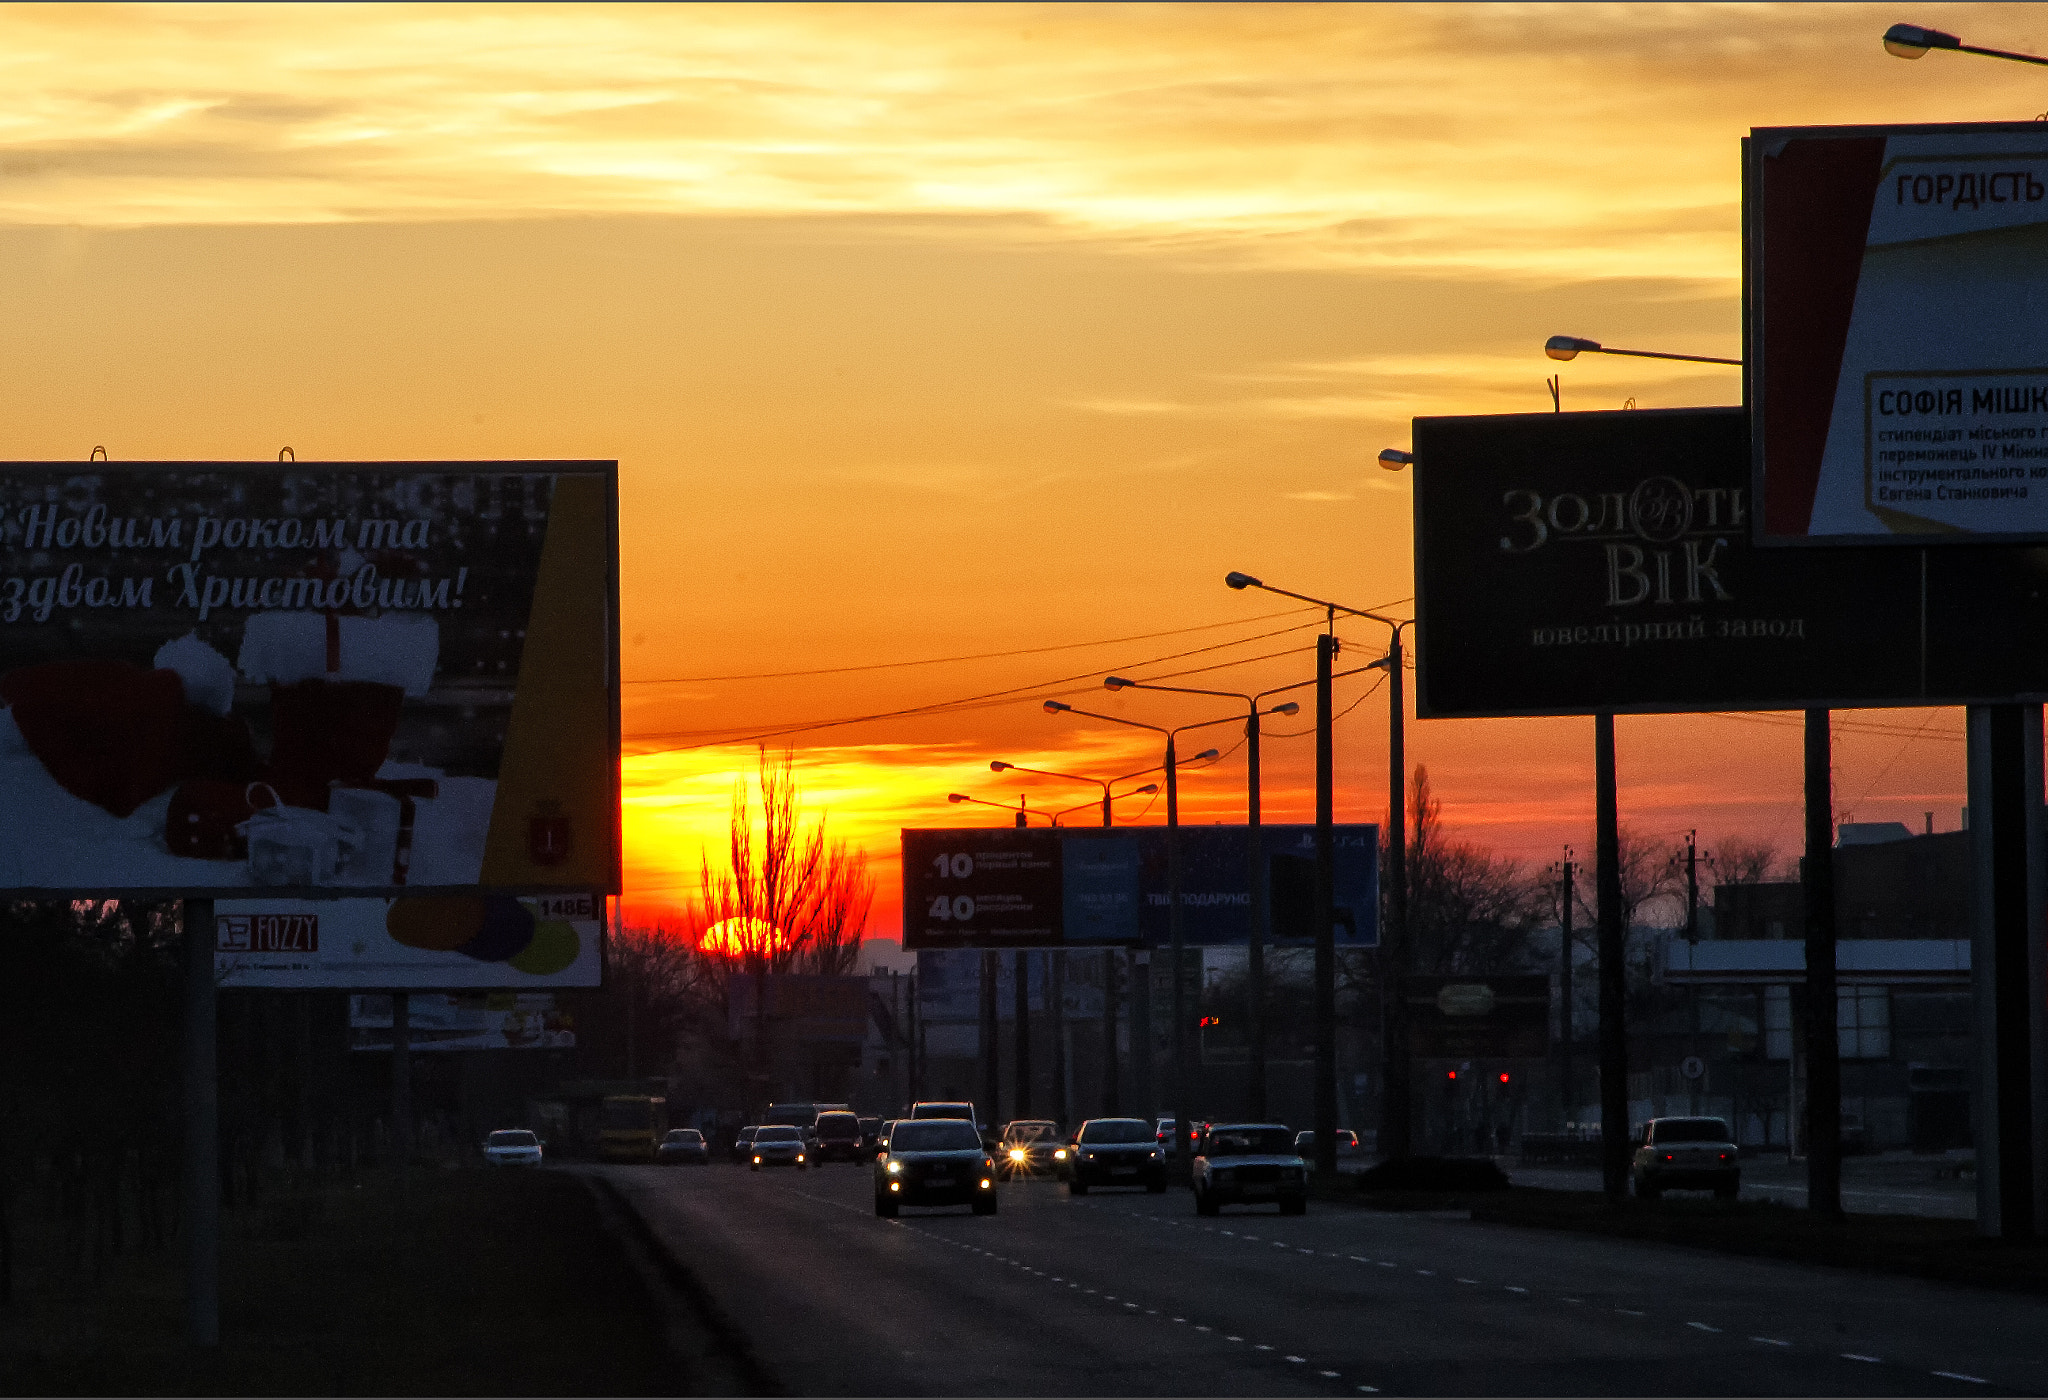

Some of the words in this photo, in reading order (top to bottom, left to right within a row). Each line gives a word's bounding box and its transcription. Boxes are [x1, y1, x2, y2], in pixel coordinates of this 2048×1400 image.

[1896, 171, 2046, 211] ГОРДІСТЬ
[1879, 388, 1963, 416] СОФІЯ
[1878, 427, 1964, 444] стипендіат
[1969, 424, 2036, 440] міського
[1879, 449, 1977, 464] переможець
[1879, 466, 2025, 485] інструментального
[1937, 484, 2029, 500] Станковича
[18, 503, 181, 549] Новим
[190, 513, 346, 564] роком
[355, 513, 431, 549] та
[166, 562, 469, 622] Христовим!
[1532, 615, 1706, 647] ювелірний
[1716, 618, 1807, 641] завод
[931, 852, 974, 879] 10
[928, 894, 975, 921] 40
[257, 916, 315, 950] FOZZY
